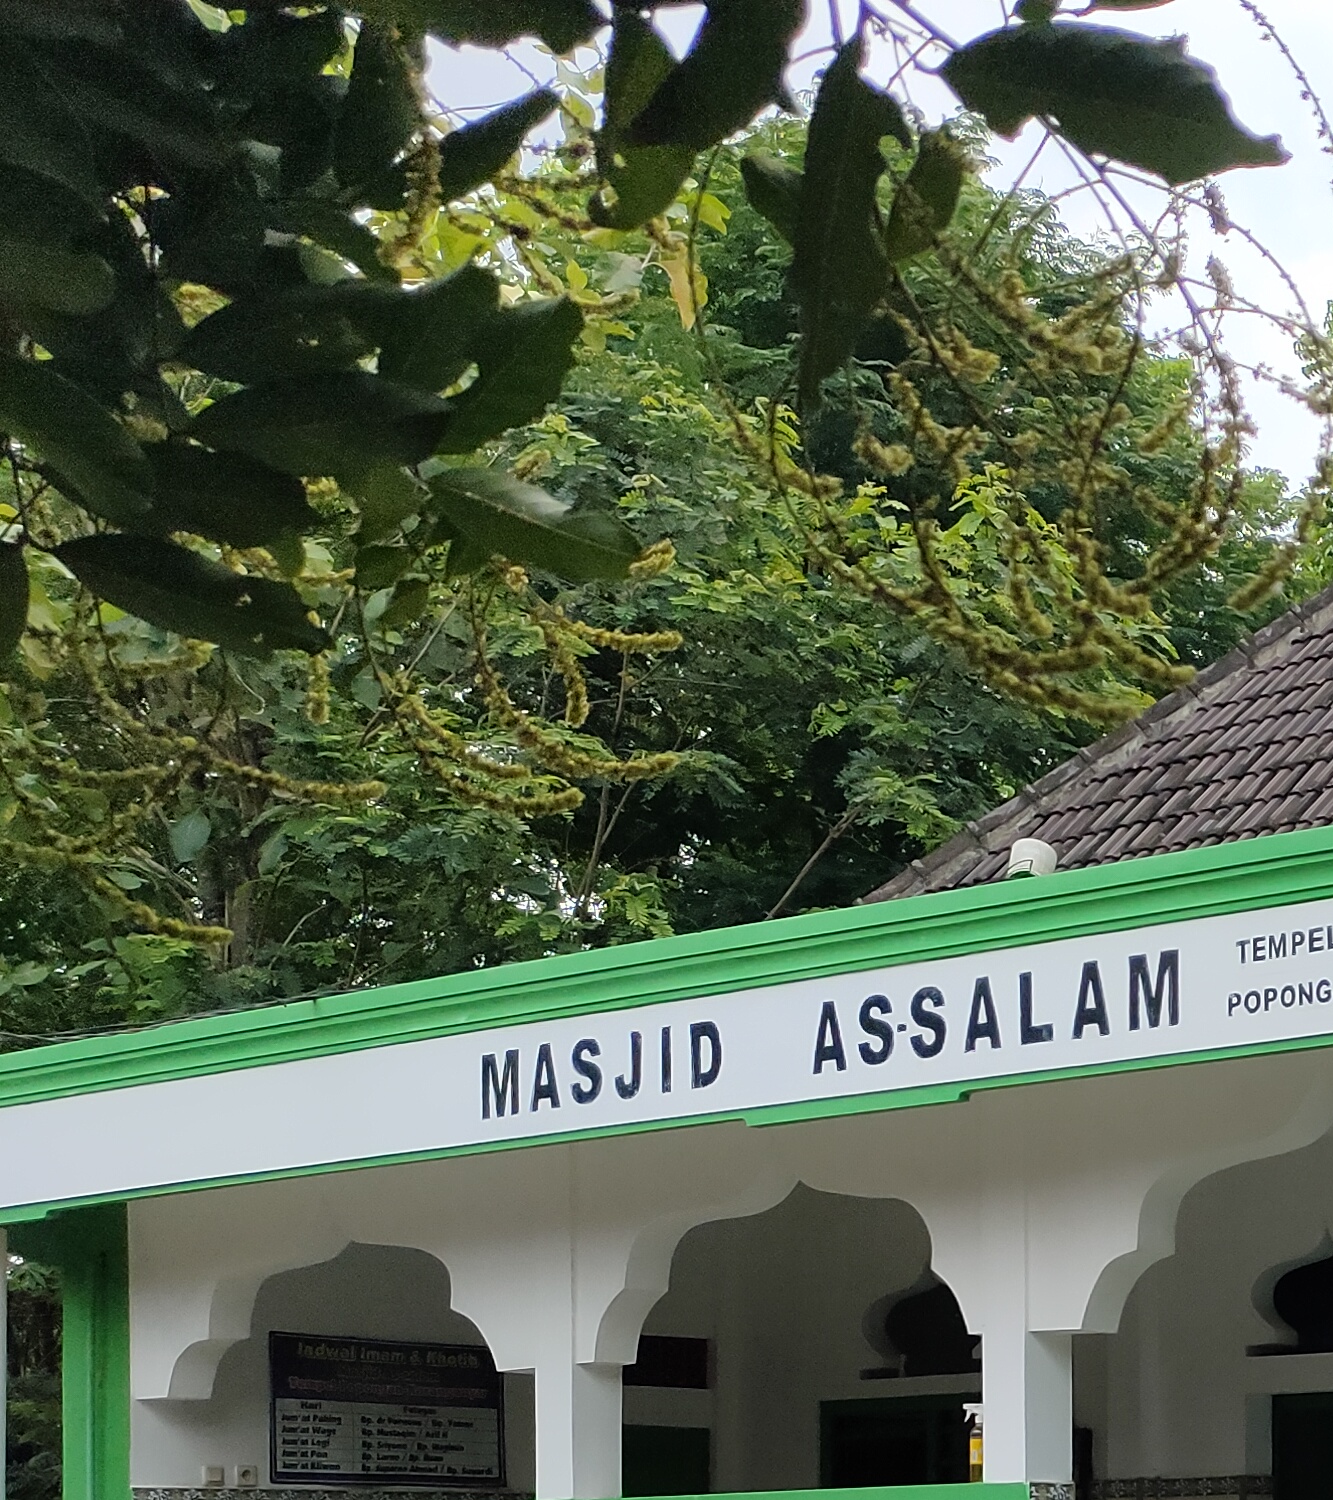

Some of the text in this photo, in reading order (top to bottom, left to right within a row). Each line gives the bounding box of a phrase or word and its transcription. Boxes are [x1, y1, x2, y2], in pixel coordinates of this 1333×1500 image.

[482, 949, 1182, 1120] MASJID AS-SALAM
[298, 1342, 356, 1361] Jadwal
[360, 1347, 404, 1363] Imam
